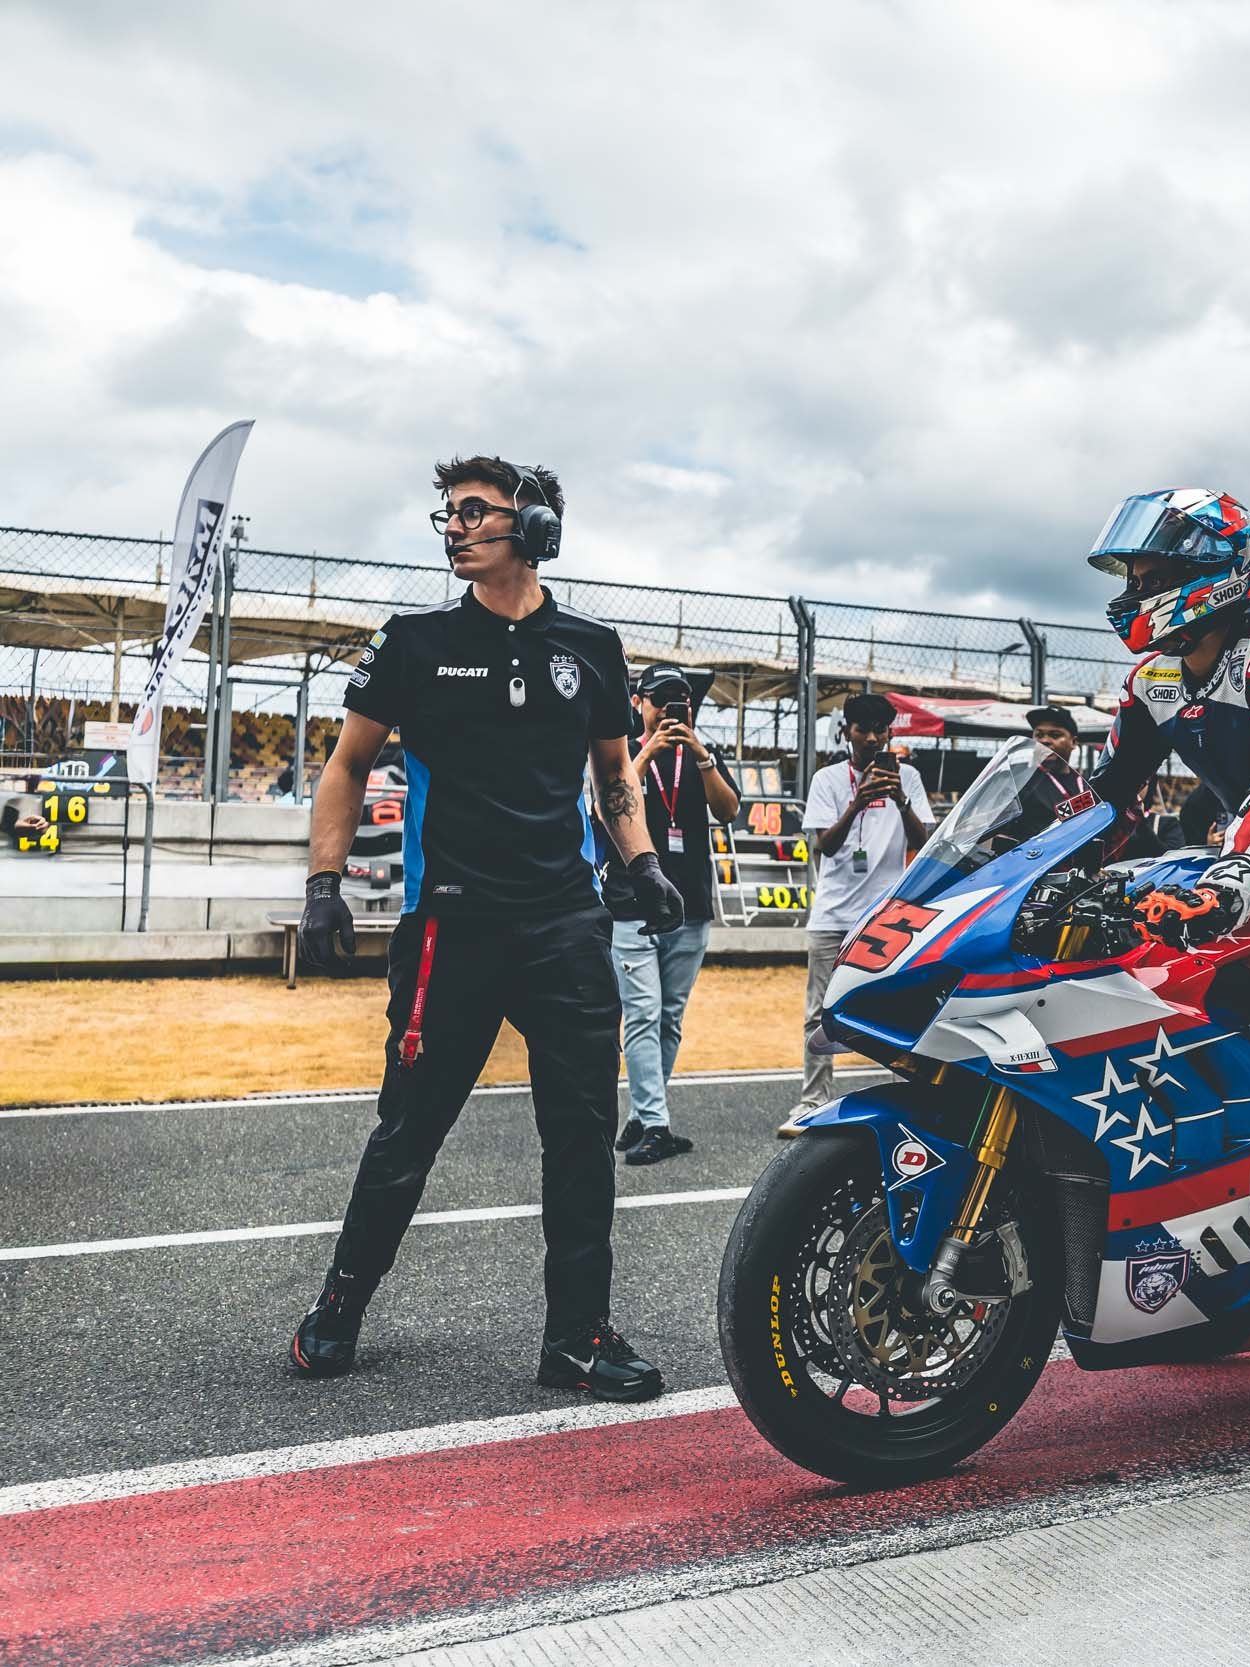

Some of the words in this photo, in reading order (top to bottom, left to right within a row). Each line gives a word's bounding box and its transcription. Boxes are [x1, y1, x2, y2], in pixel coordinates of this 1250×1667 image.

[1212, 583, 1244, 606] SHOEI
[437, 666, 489, 678] DUCATI
[1145, 670, 1181, 679] DUNLOP
[1152, 688, 1177, 700] SHOEI
[44, 795, 86, 823] 16
[747, 802, 783, 835] 46
[832, 897, 945, 974] 5
[770, 1275, 795, 1388] DUNLOP
